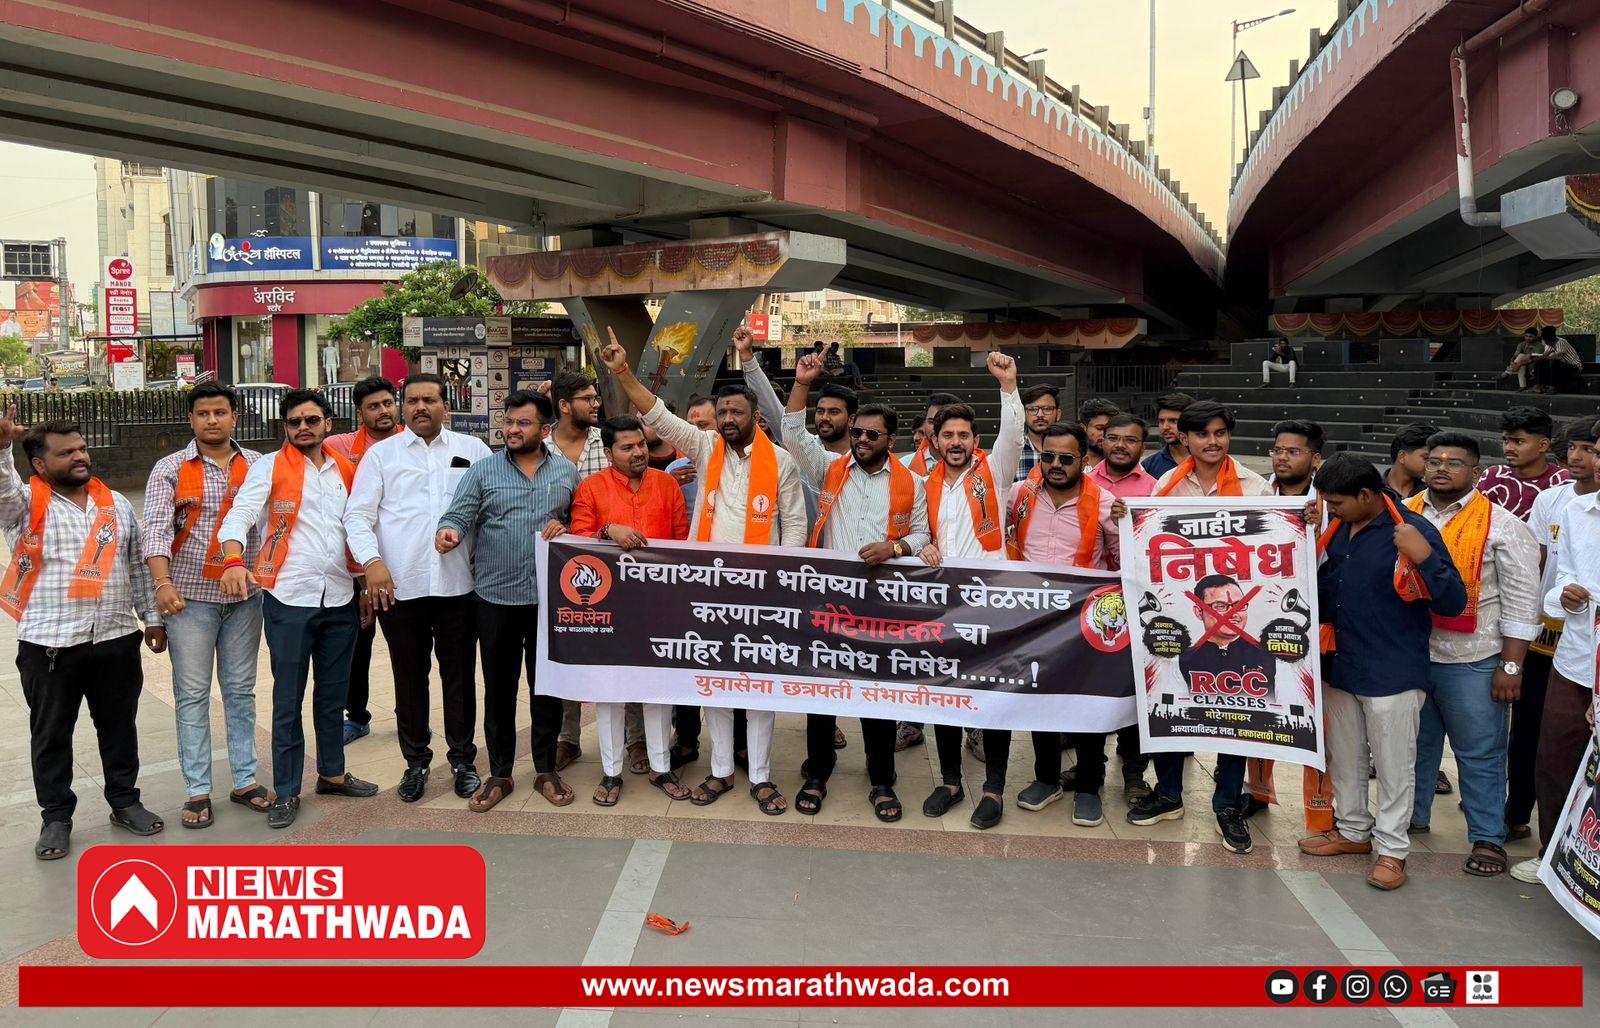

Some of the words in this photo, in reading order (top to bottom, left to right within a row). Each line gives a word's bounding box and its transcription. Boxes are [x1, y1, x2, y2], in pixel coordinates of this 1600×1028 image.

[264, 246, 301, 260] हॉस्पिटल
[110, 267, 131, 275] Spree
[254, 287, 296, 304] अरविंद
[1178, 510, 1248, 536] जाहीर
[1146, 532, 1296, 584] निषेध
[616, 554, 768, 590] विद्यार्थ्यांच्या
[776, 564, 868, 600] भविष्या
[876, 572, 950, 605] सोबत
[957, 576, 1072, 610] खेळसांड
[556, 607, 612, 624] शिवसेना
[810, 603, 946, 644] मोटेगावकर
[953, 623, 990, 645] चा
[649, 630, 723, 666] जाहिर
[731, 633, 801, 666] निषेध
[809, 640, 880, 672] निषेध
[694, 672, 774, 697] युवासेना
[781, 680, 853, 700] छत्रपती
[860, 682, 980, 711] संभाजीनगर.
[1189, 670, 1268, 697] RCC
[1193, 694, 1266, 709] CLASSES
[1205, 709, 1252, 722] मोटेगावकर
[1574, 836, 1600, 873] CLASS
